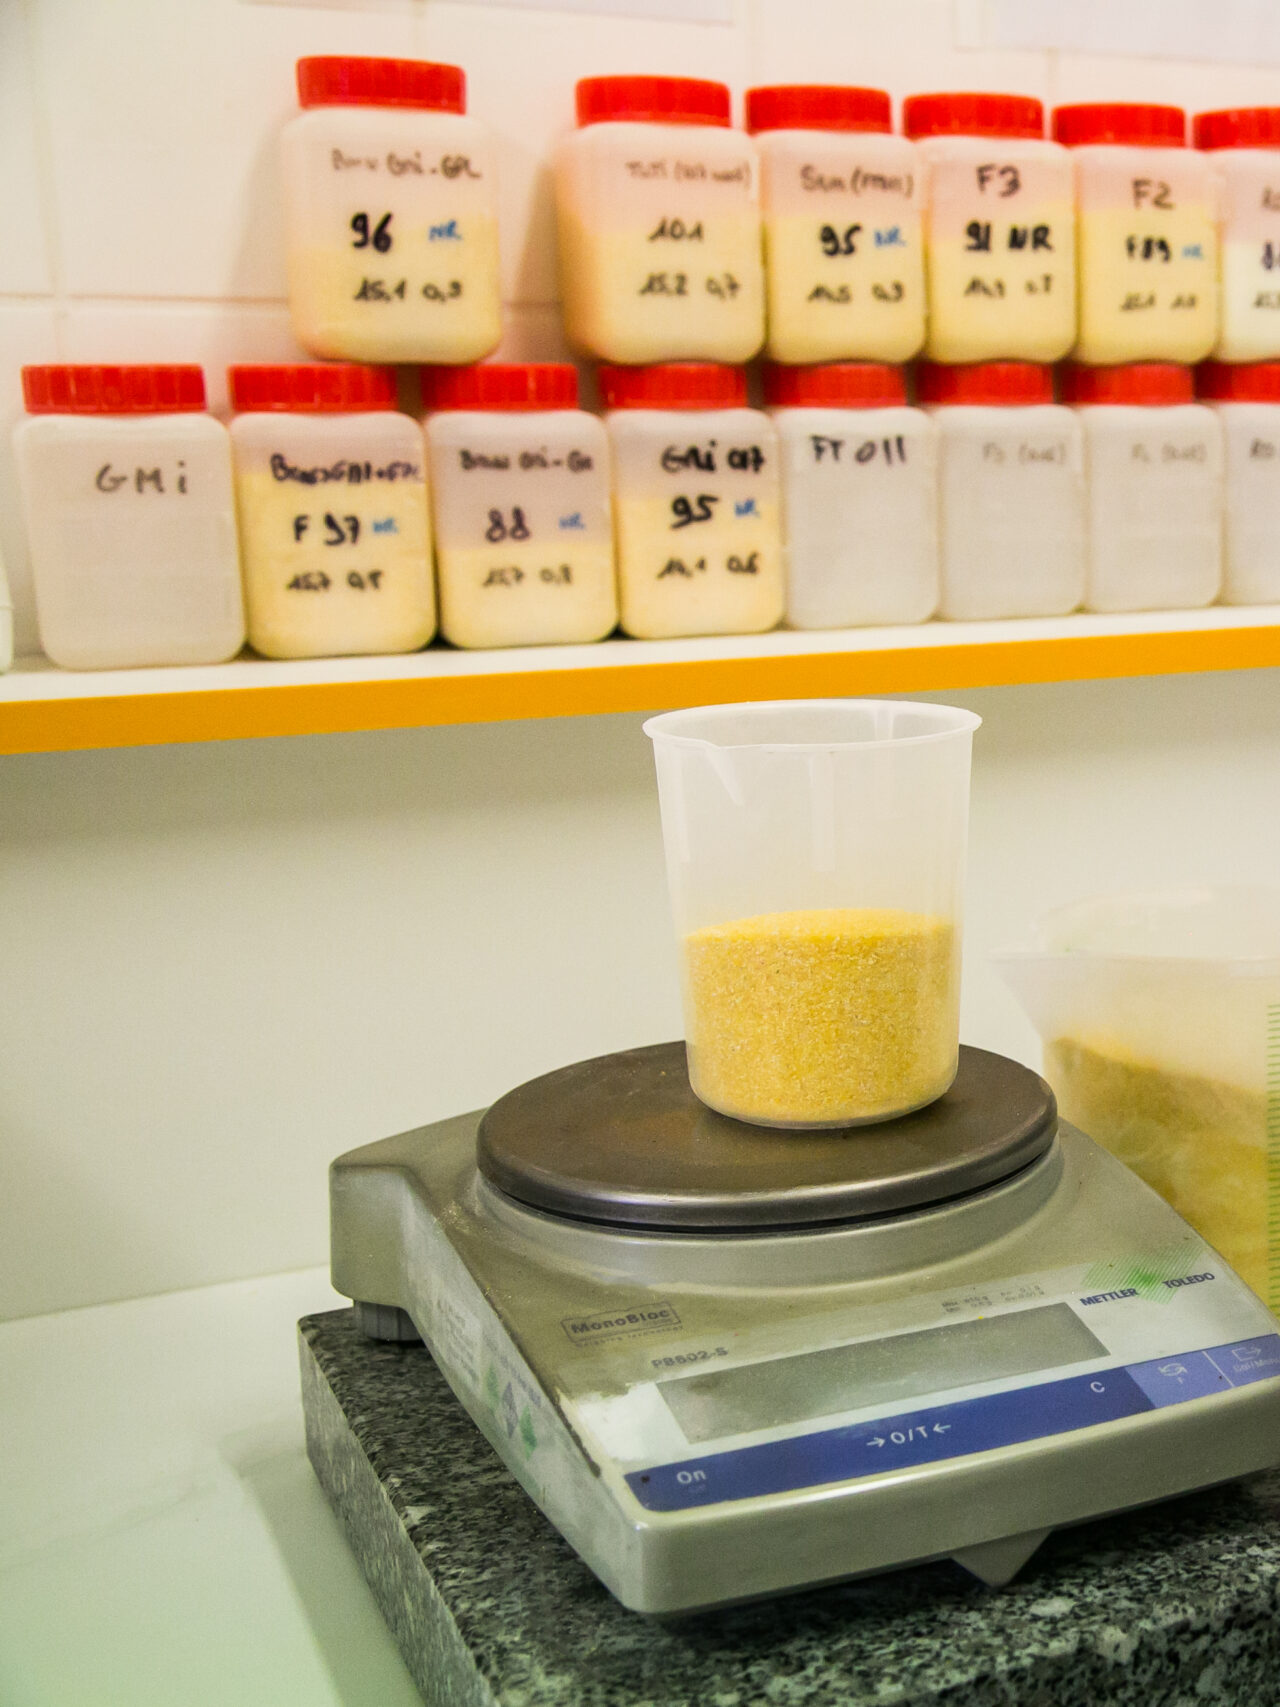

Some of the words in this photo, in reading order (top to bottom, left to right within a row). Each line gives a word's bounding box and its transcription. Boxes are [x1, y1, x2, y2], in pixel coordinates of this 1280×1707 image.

[976, 164, 1022, 198] F3
[1132, 179, 1175, 211] F2
[350, 211, 393, 253] 96
[820, 223, 863, 257] 95
[1008, 224, 1054, 253] NR
[293, 514, 310, 543] F
[484, 505, 532, 543] 88
[669, 495, 719, 529] 95
[1080, 1287, 1139, 1307] METTLER
[1162, 1272, 1215, 1289] TOLEDO
[571, 1308, 670, 1335] MonoBloc
[1090, 1381, 1105, 1393] C
[676, 1469, 707, 1485] On
